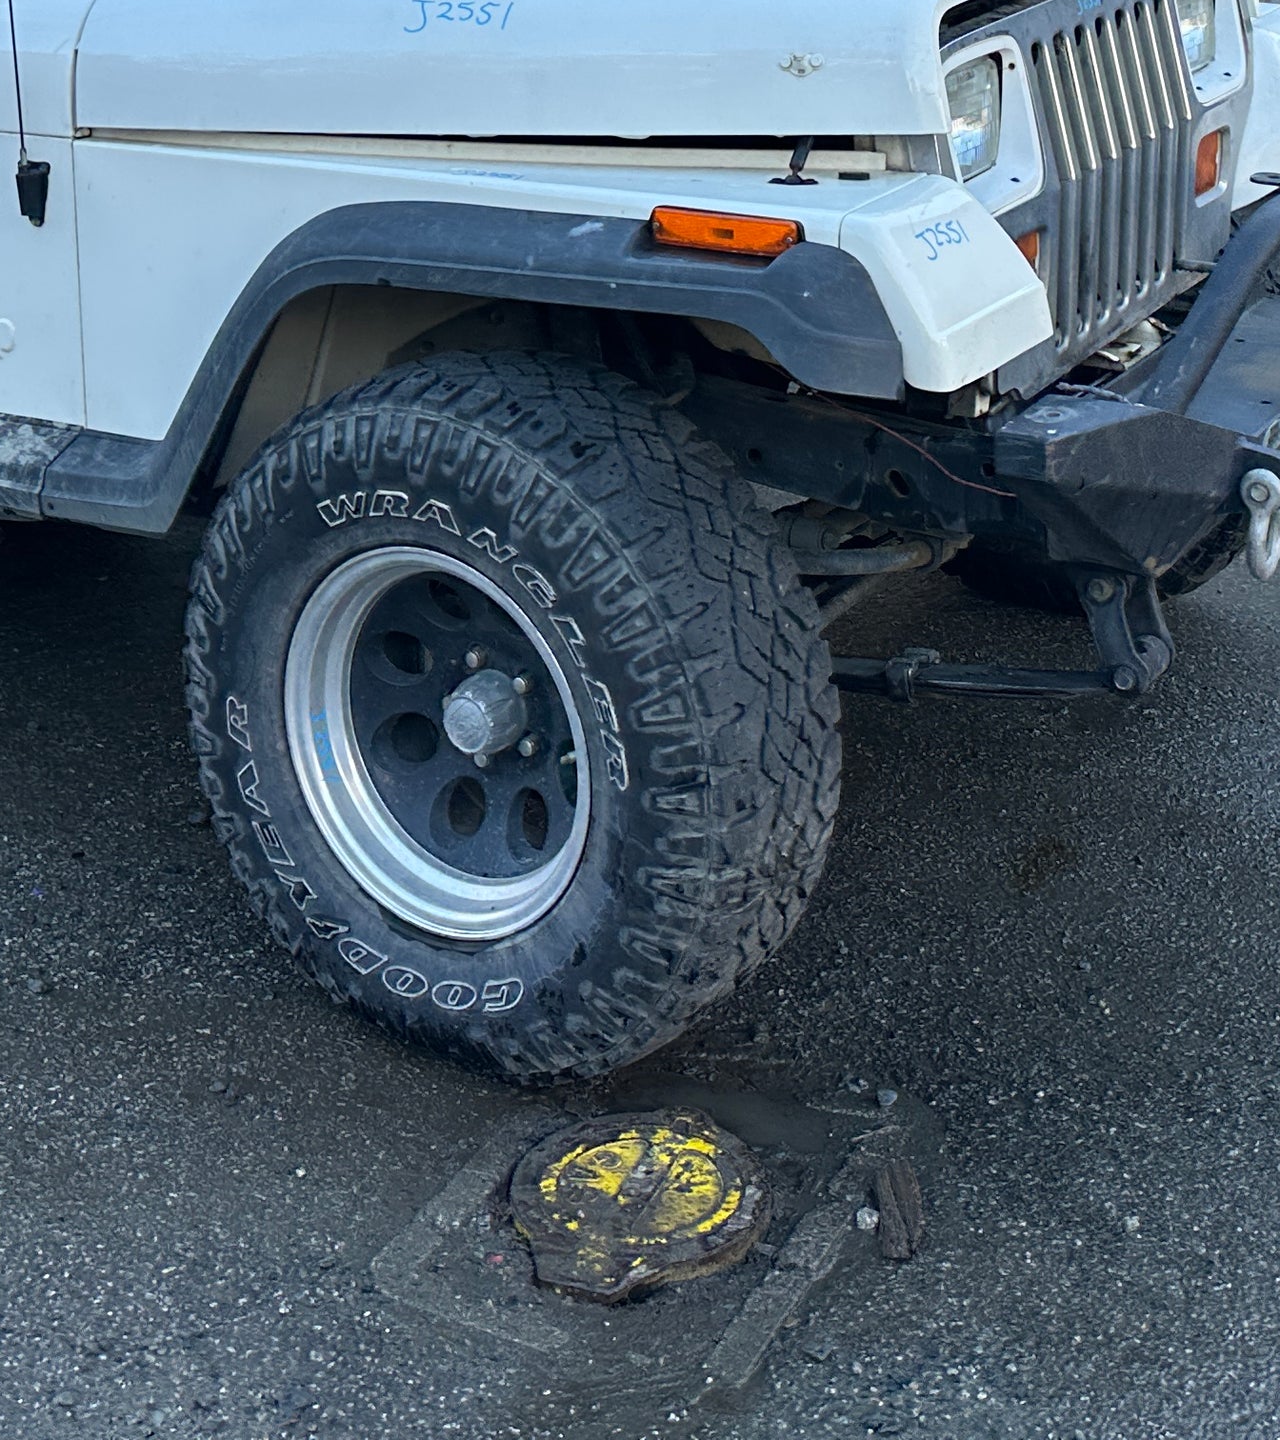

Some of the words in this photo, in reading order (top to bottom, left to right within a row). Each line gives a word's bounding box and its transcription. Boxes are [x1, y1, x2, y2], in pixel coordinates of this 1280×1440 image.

[403, 0, 515, 33] J2551
[914, 220, 970, 260] J2551
[316, 489, 630, 792] WRANGLER
[226, 695, 525, 1013] GOODYEAR
